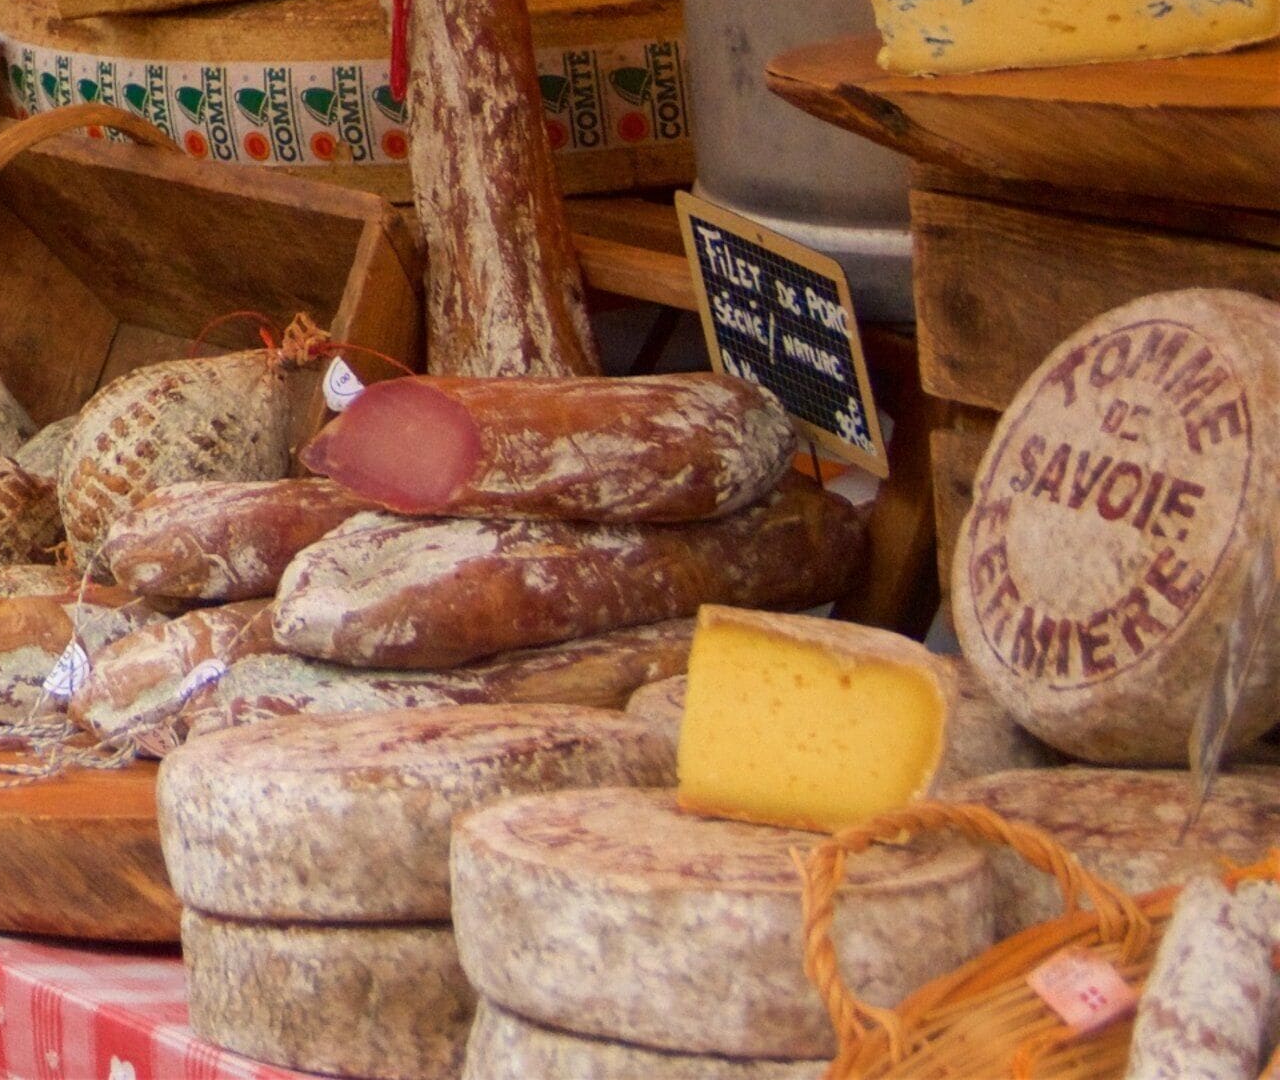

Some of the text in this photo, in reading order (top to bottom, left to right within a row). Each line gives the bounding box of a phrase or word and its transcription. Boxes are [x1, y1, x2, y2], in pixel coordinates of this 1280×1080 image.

[268, 67, 298, 163] COMTÉ
[1044, 325, 1244, 454] TOMME
[1010, 432, 1206, 542] SAVOIE
